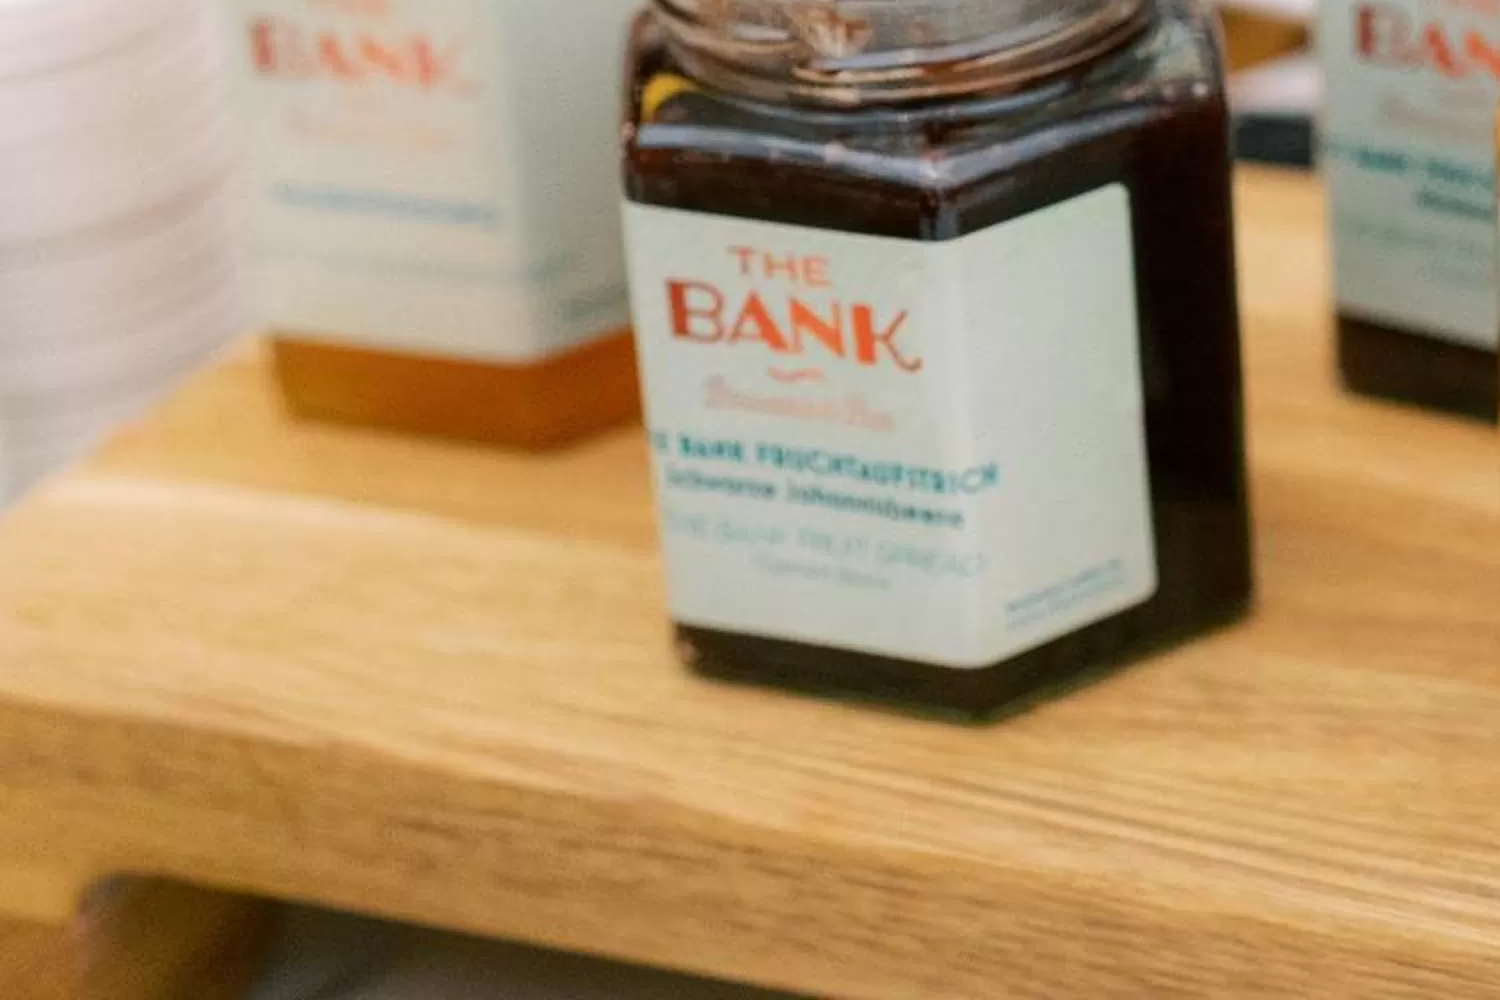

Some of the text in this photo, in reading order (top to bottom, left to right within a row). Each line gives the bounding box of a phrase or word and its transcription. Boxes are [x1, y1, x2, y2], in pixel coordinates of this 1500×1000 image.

[729, 245, 832, 285] THE
[665, 278, 922, 373] BANK
[679, 432, 743, 463] BANK
